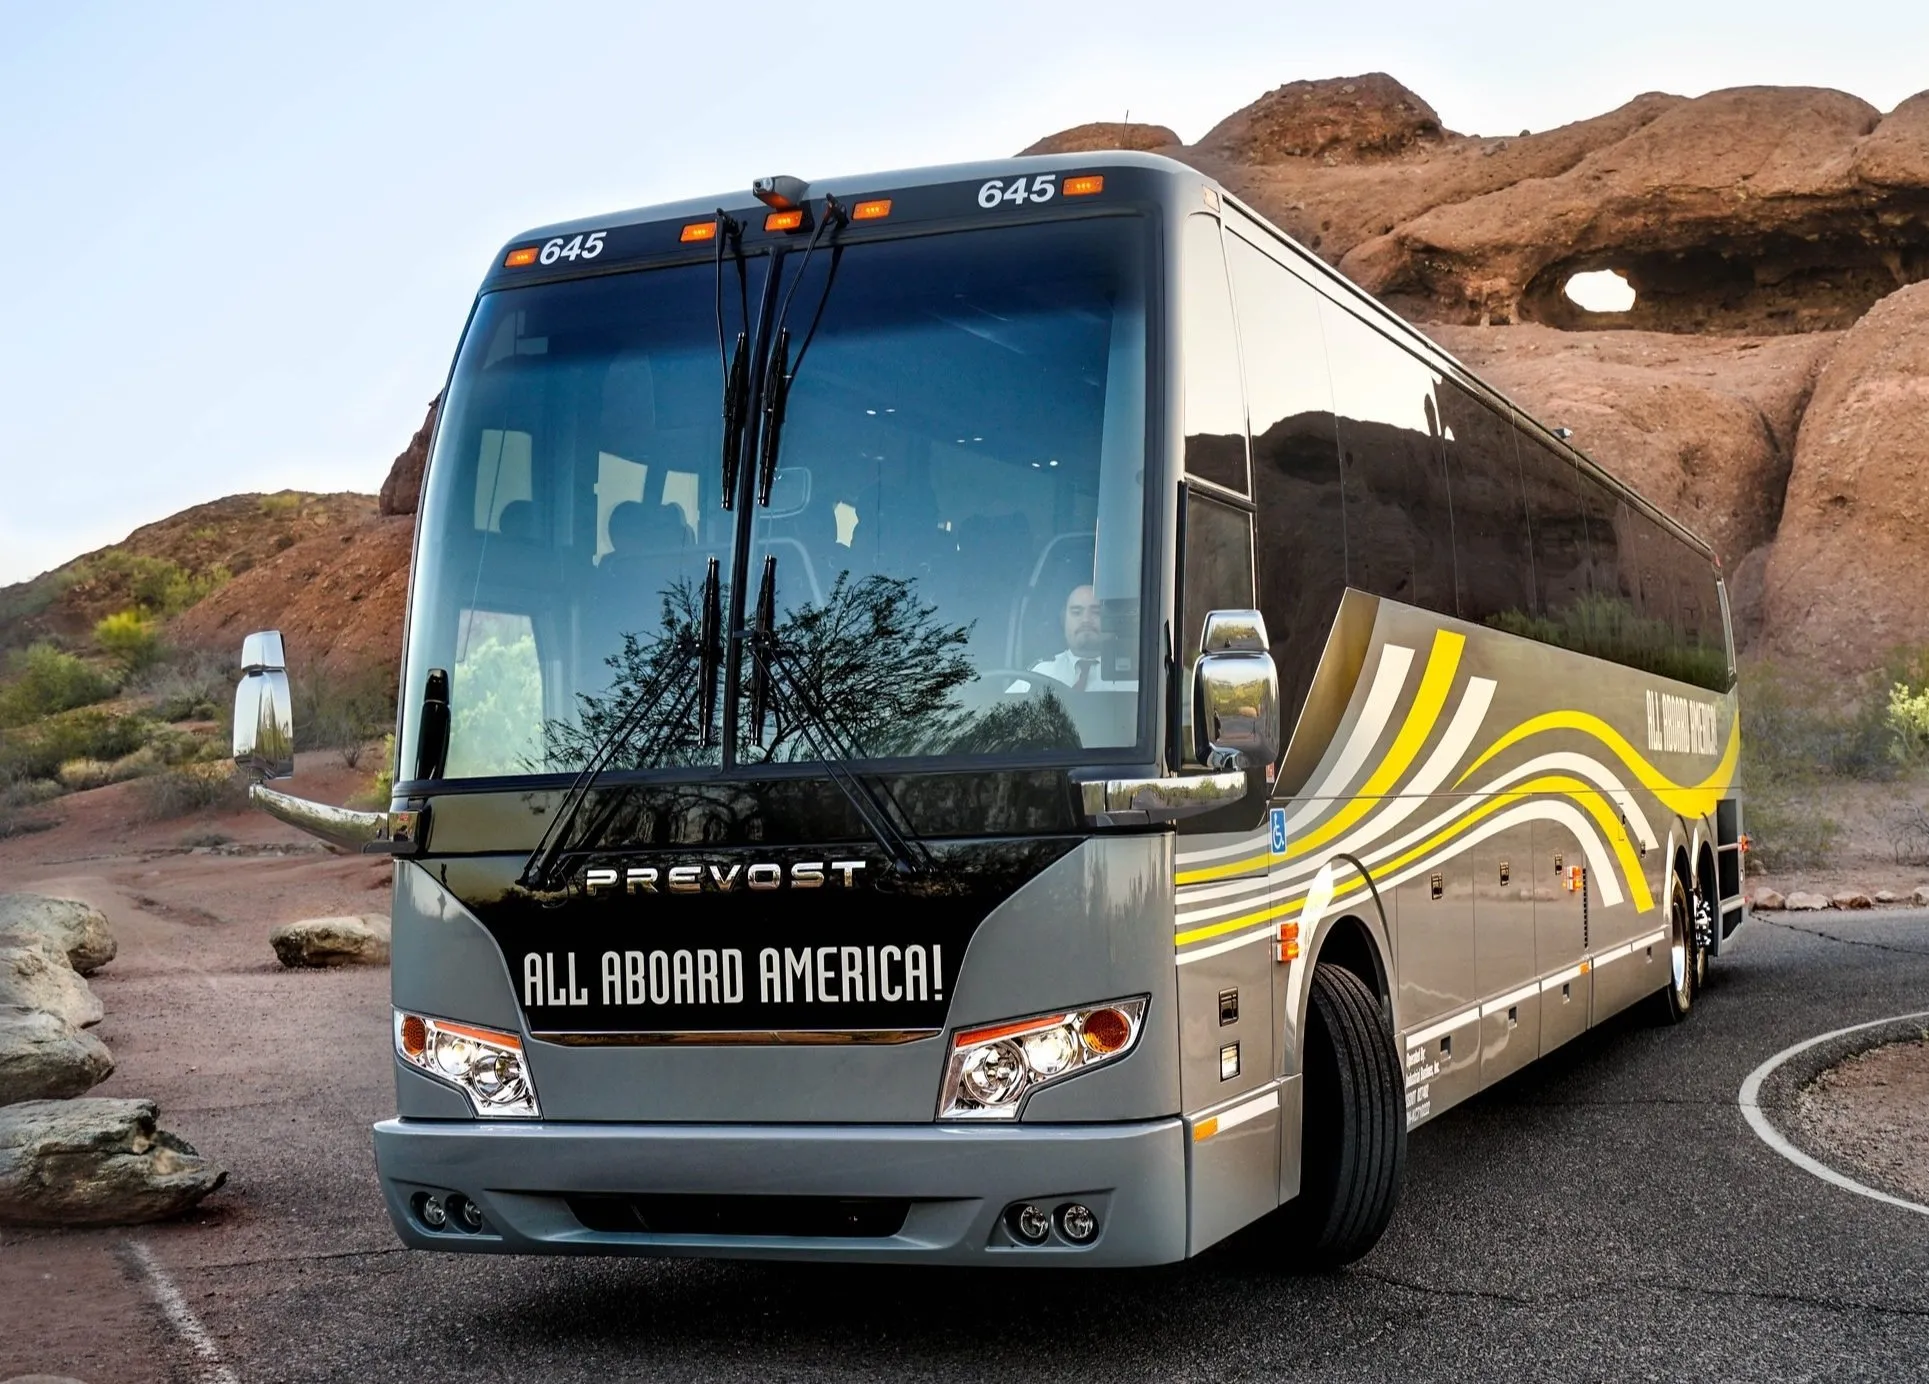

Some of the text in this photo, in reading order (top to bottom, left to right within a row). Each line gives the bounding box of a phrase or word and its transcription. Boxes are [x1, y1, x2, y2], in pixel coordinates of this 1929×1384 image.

[976, 174, 1056, 208] 645
[539, 232, 607, 265] 645
[1646, 689, 1662, 751] ALL
[586, 861, 866, 896] PREVOST
[523, 944, 944, 1006] ALL ABOARD AMERICA!
